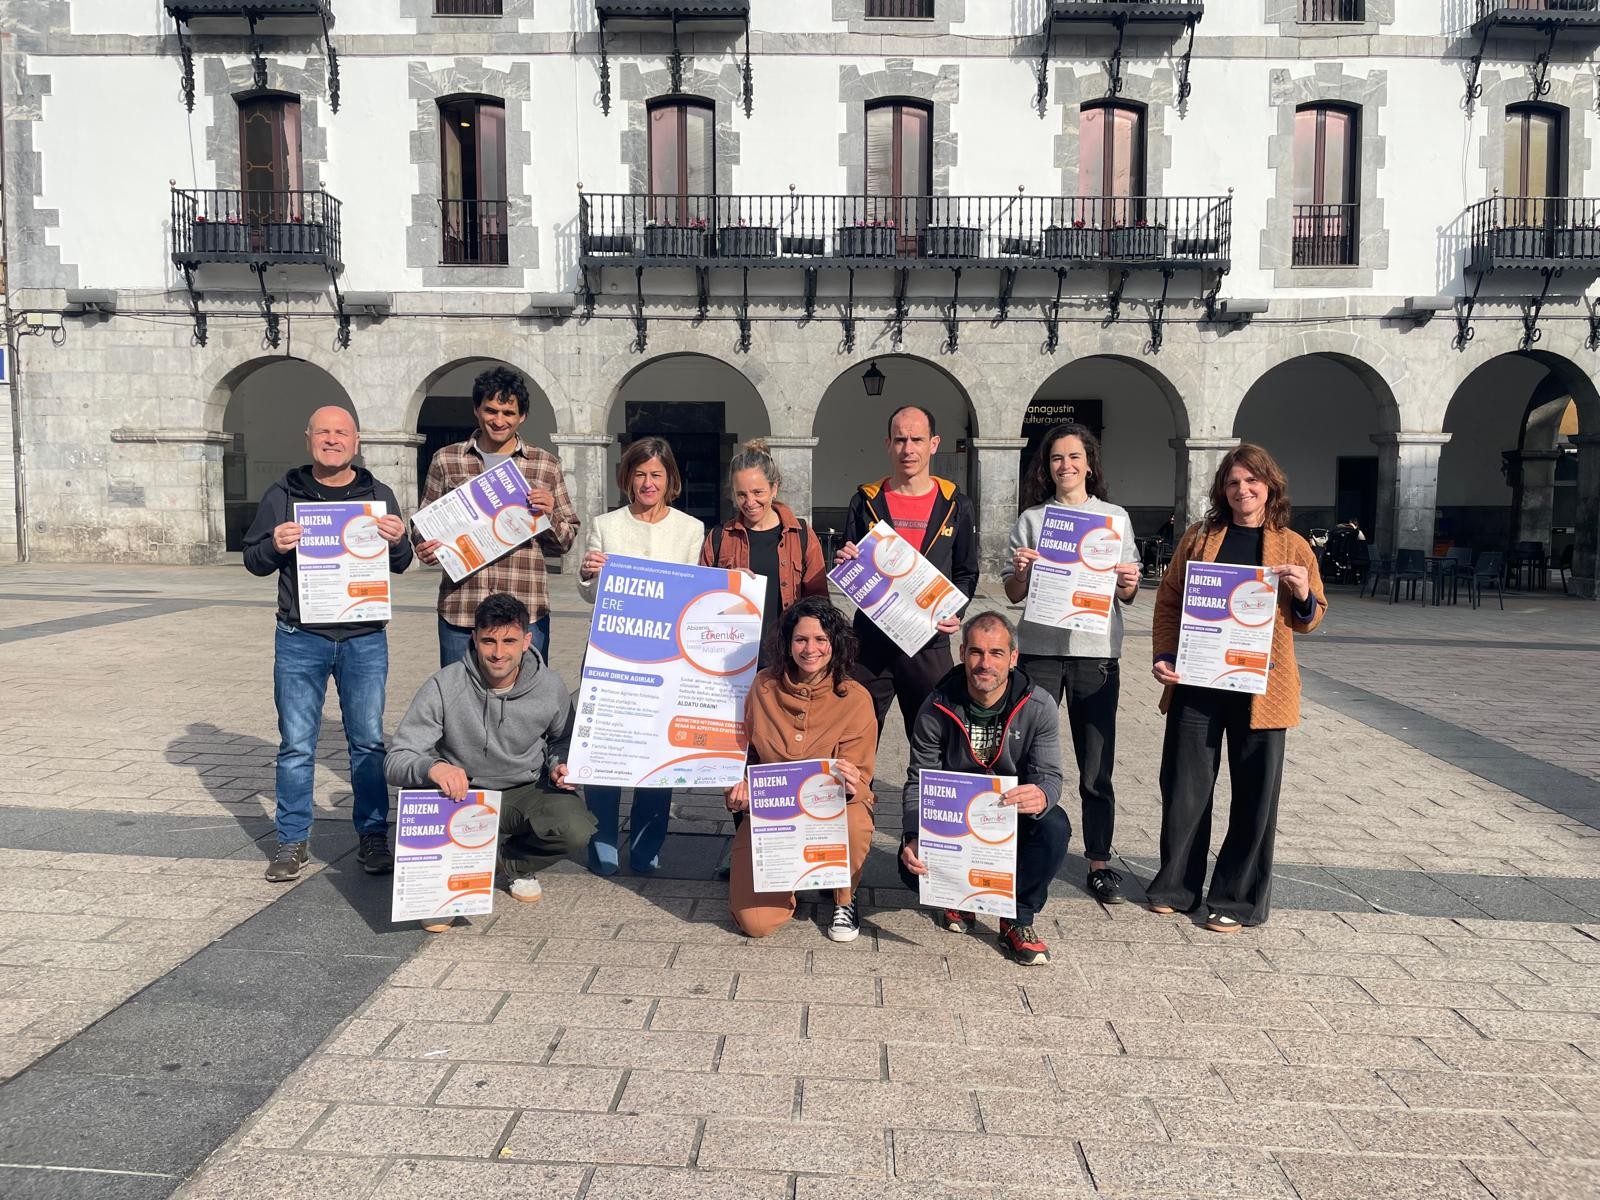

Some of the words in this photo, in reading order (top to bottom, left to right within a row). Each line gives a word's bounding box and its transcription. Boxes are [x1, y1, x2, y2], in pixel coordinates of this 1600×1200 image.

[1027, 404, 1074, 415] anagustin
[487, 472, 496, 484] ERE
[494, 467, 516, 495] ABIZENA
[477, 477, 503, 510] EUSKARAZ
[300, 515, 332, 526] ABIZENA
[1044, 518, 1074, 532] ABIZENA
[300, 535, 340, 546] EUSKARAZ
[1040, 538, 1078, 553] EUSKARAZ
[839, 562, 864, 588] ABIZENA
[1189, 575, 1222, 587] ABIZENA
[604, 575, 664, 599] ABIZENA
[853, 572, 884, 603] EUSKARAZ
[602, 598, 624, 611] ERE
[1188, 595, 1227, 609] EUSKARAZ
[598, 614, 672, 640] EUSKARAZ
[589, 670, 609, 678] BEHAR
[753, 776, 787, 788] ABIZENA
[923, 784, 956, 798] ABIZENA
[754, 796, 795, 808] EUSKARAZ
[402, 804, 439, 814] ABIZENA
[923, 808, 963, 824] EUSKARAZ
[401, 825, 446, 836] EUSKARAZ
